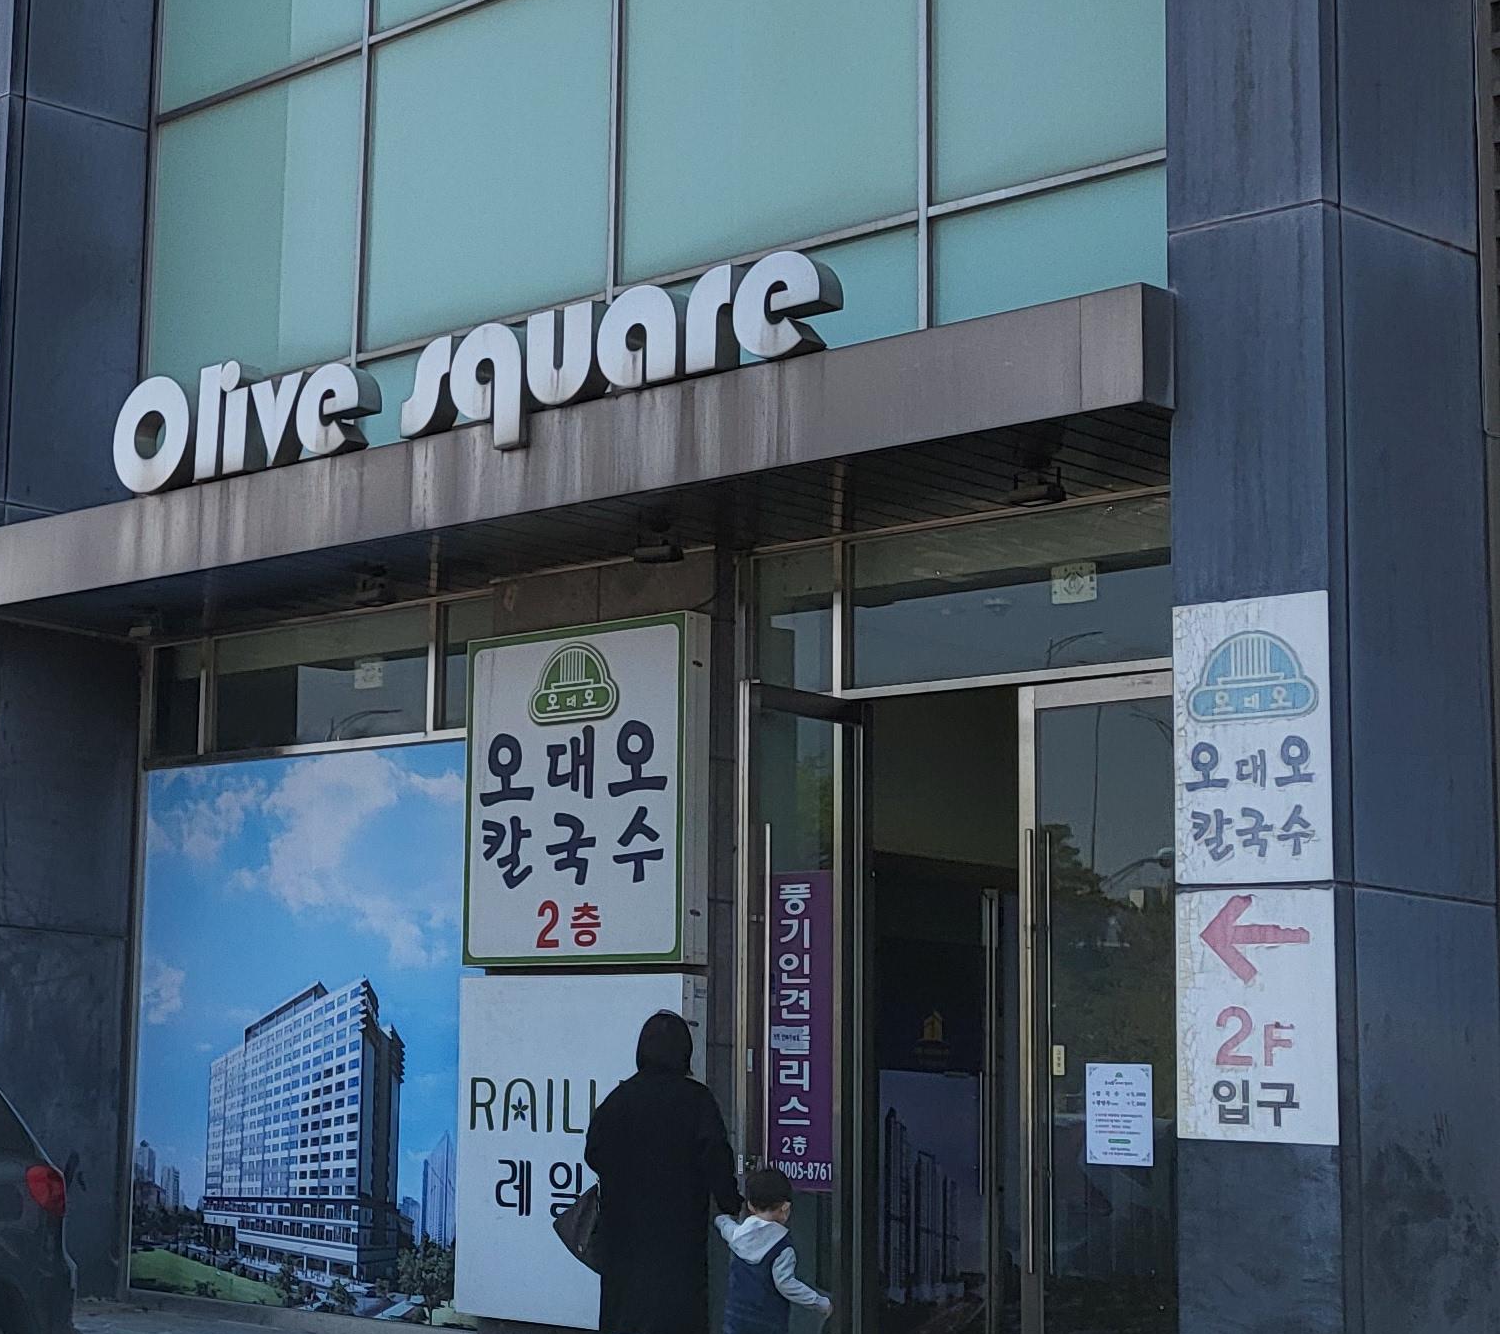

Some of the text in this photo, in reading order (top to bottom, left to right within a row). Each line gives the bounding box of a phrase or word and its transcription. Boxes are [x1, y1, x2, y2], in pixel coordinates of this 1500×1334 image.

[113, 250, 830, 495] Olive square
[546, 689, 598, 711] 오대오
[1212, 686, 1294, 714] 오대오
[479, 719, 668, 808] 오대오
[1185, 735, 1316, 792] 오대오
[481, 805, 664, 890] 칼국수
[1190, 804, 1316, 861] 칼국수
[535, 899, 602, 949] 2층
[1216, 1005, 1295, 1067] 2F
[1212, 1079, 1300, 1128] 입구
[782, 1135, 808, 1156] 2층
